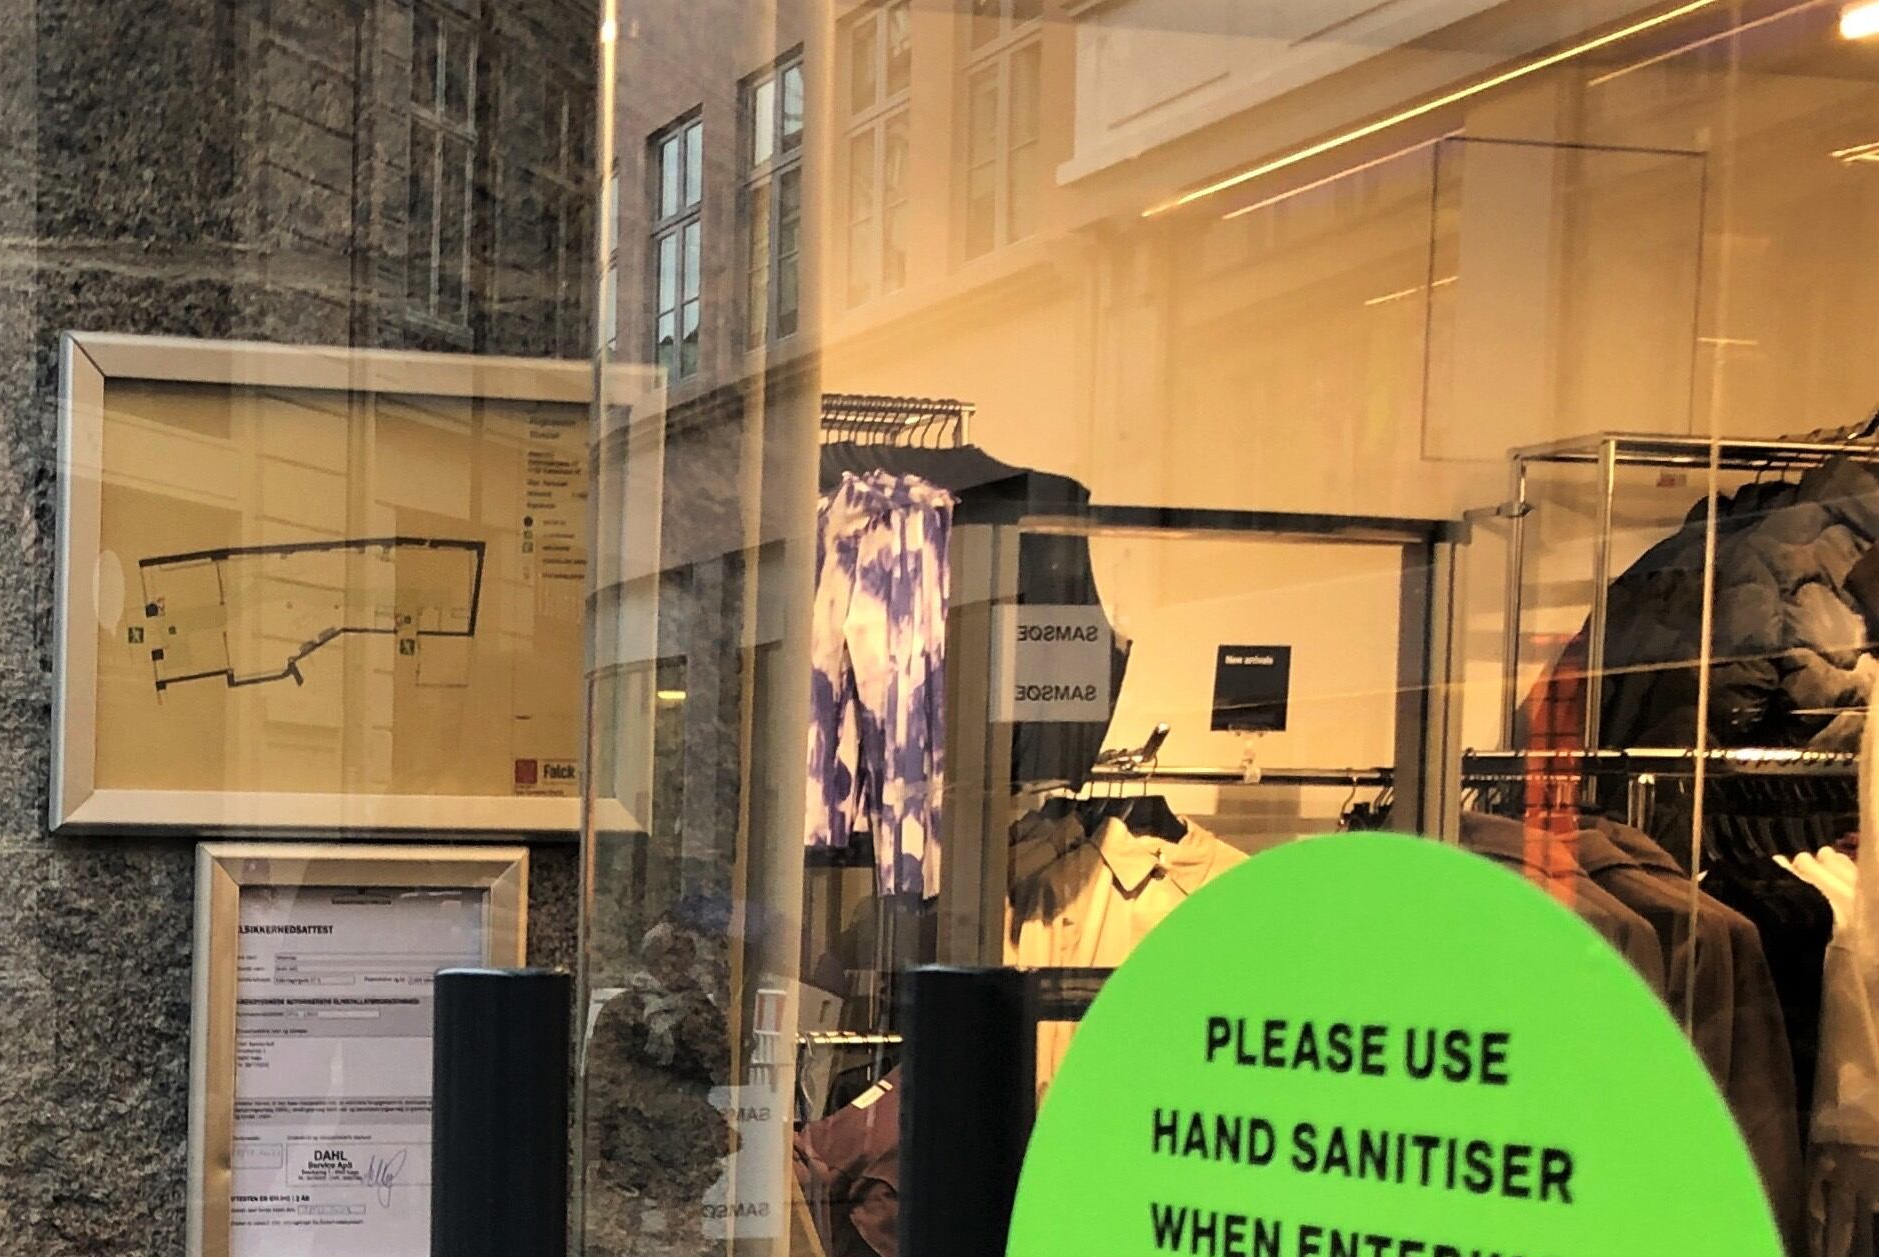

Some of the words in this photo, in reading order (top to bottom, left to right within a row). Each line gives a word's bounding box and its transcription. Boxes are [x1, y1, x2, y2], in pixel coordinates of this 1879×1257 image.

[543, 764, 575, 779] Falck
[1205, 1016, 1389, 1077] PLEASE
[1405, 1027, 1511, 1086] USE
[313, 1149, 348, 1161] DAHL
[1152, 1107, 1278, 1167] HAND
[1291, 1121, 1575, 1204] SANITISER
